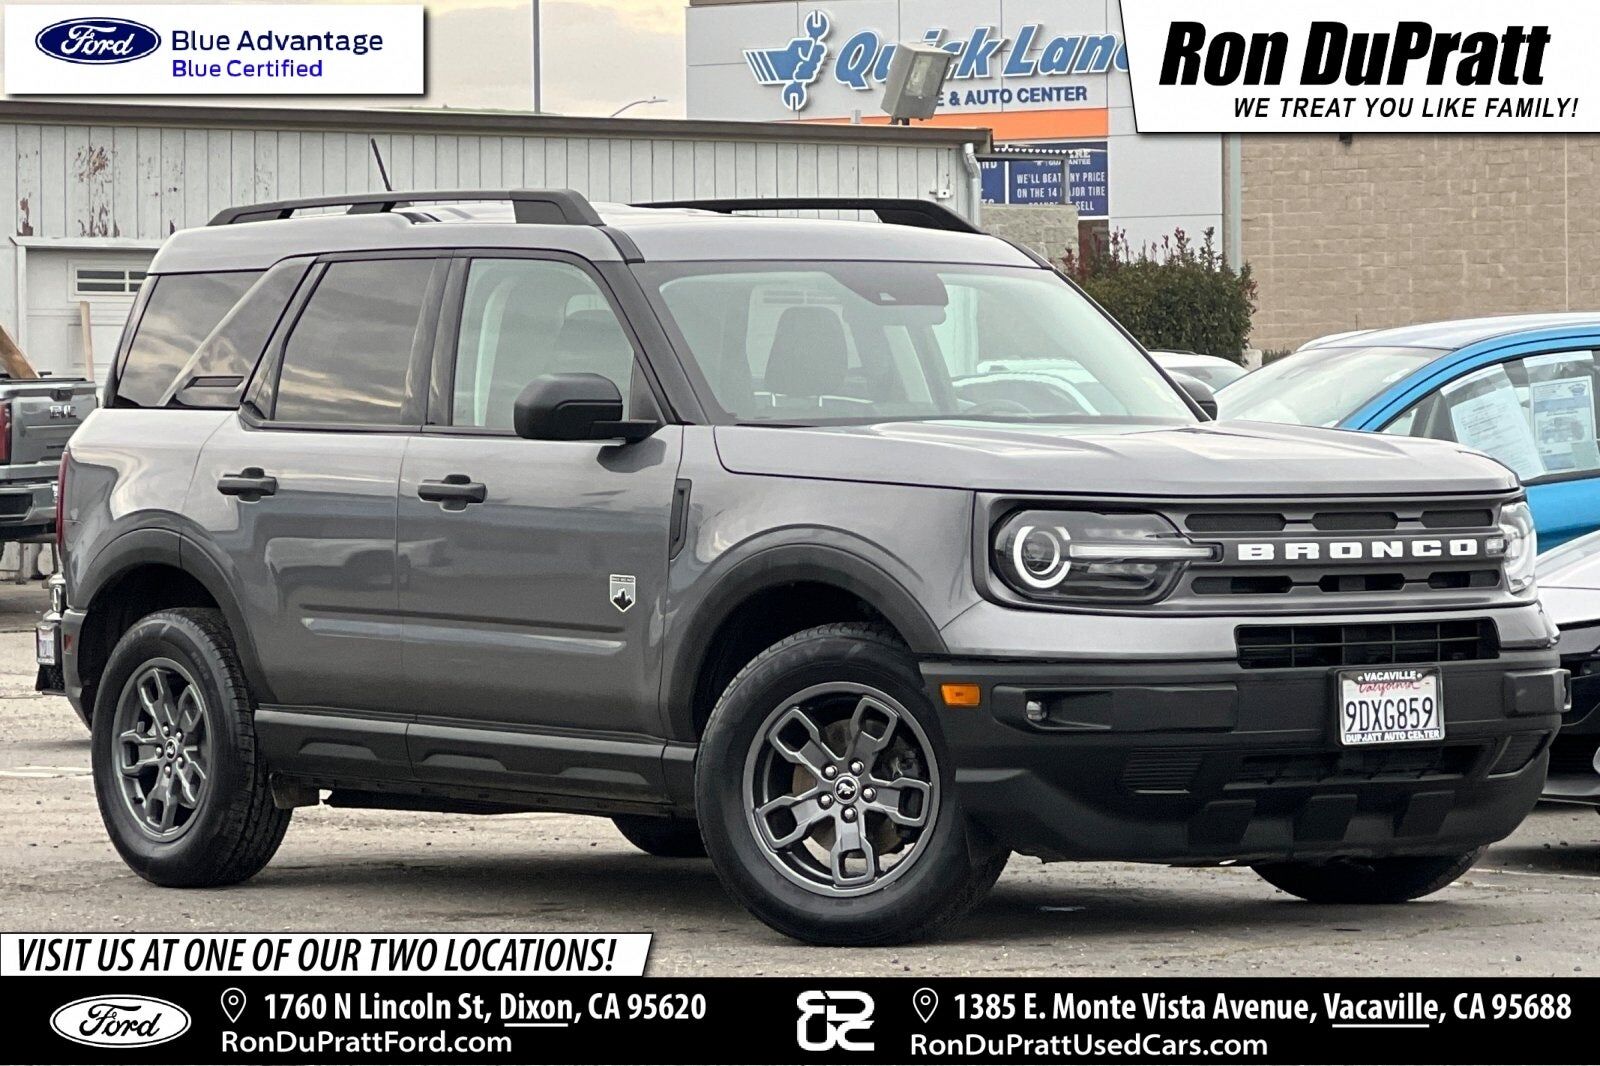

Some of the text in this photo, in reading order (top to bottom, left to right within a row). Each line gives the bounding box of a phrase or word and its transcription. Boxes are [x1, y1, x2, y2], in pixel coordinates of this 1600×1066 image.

[949, 91, 960, 106] &
[965, 89, 1012, 106] AUTO
[1017, 86, 1087, 103] CENTER
[1017, 173, 1040, 184] WE'LL
[1042, 173, 1062, 183] BEAT
[1082, 171, 1105, 182] PRICE
[1016, 188, 1028, 198] ON
[1030, 188, 1045, 198] THE
[1048, 187, 1058, 197] 14
[1088, 186, 1106, 197] TIRE
[1237, 538, 1478, 561] BRONCO
[1363, 671, 1417, 682] VACAVILLE
[1345, 697, 1434, 732] 9DXG859
[1384, 731, 1406, 741] AUTO
